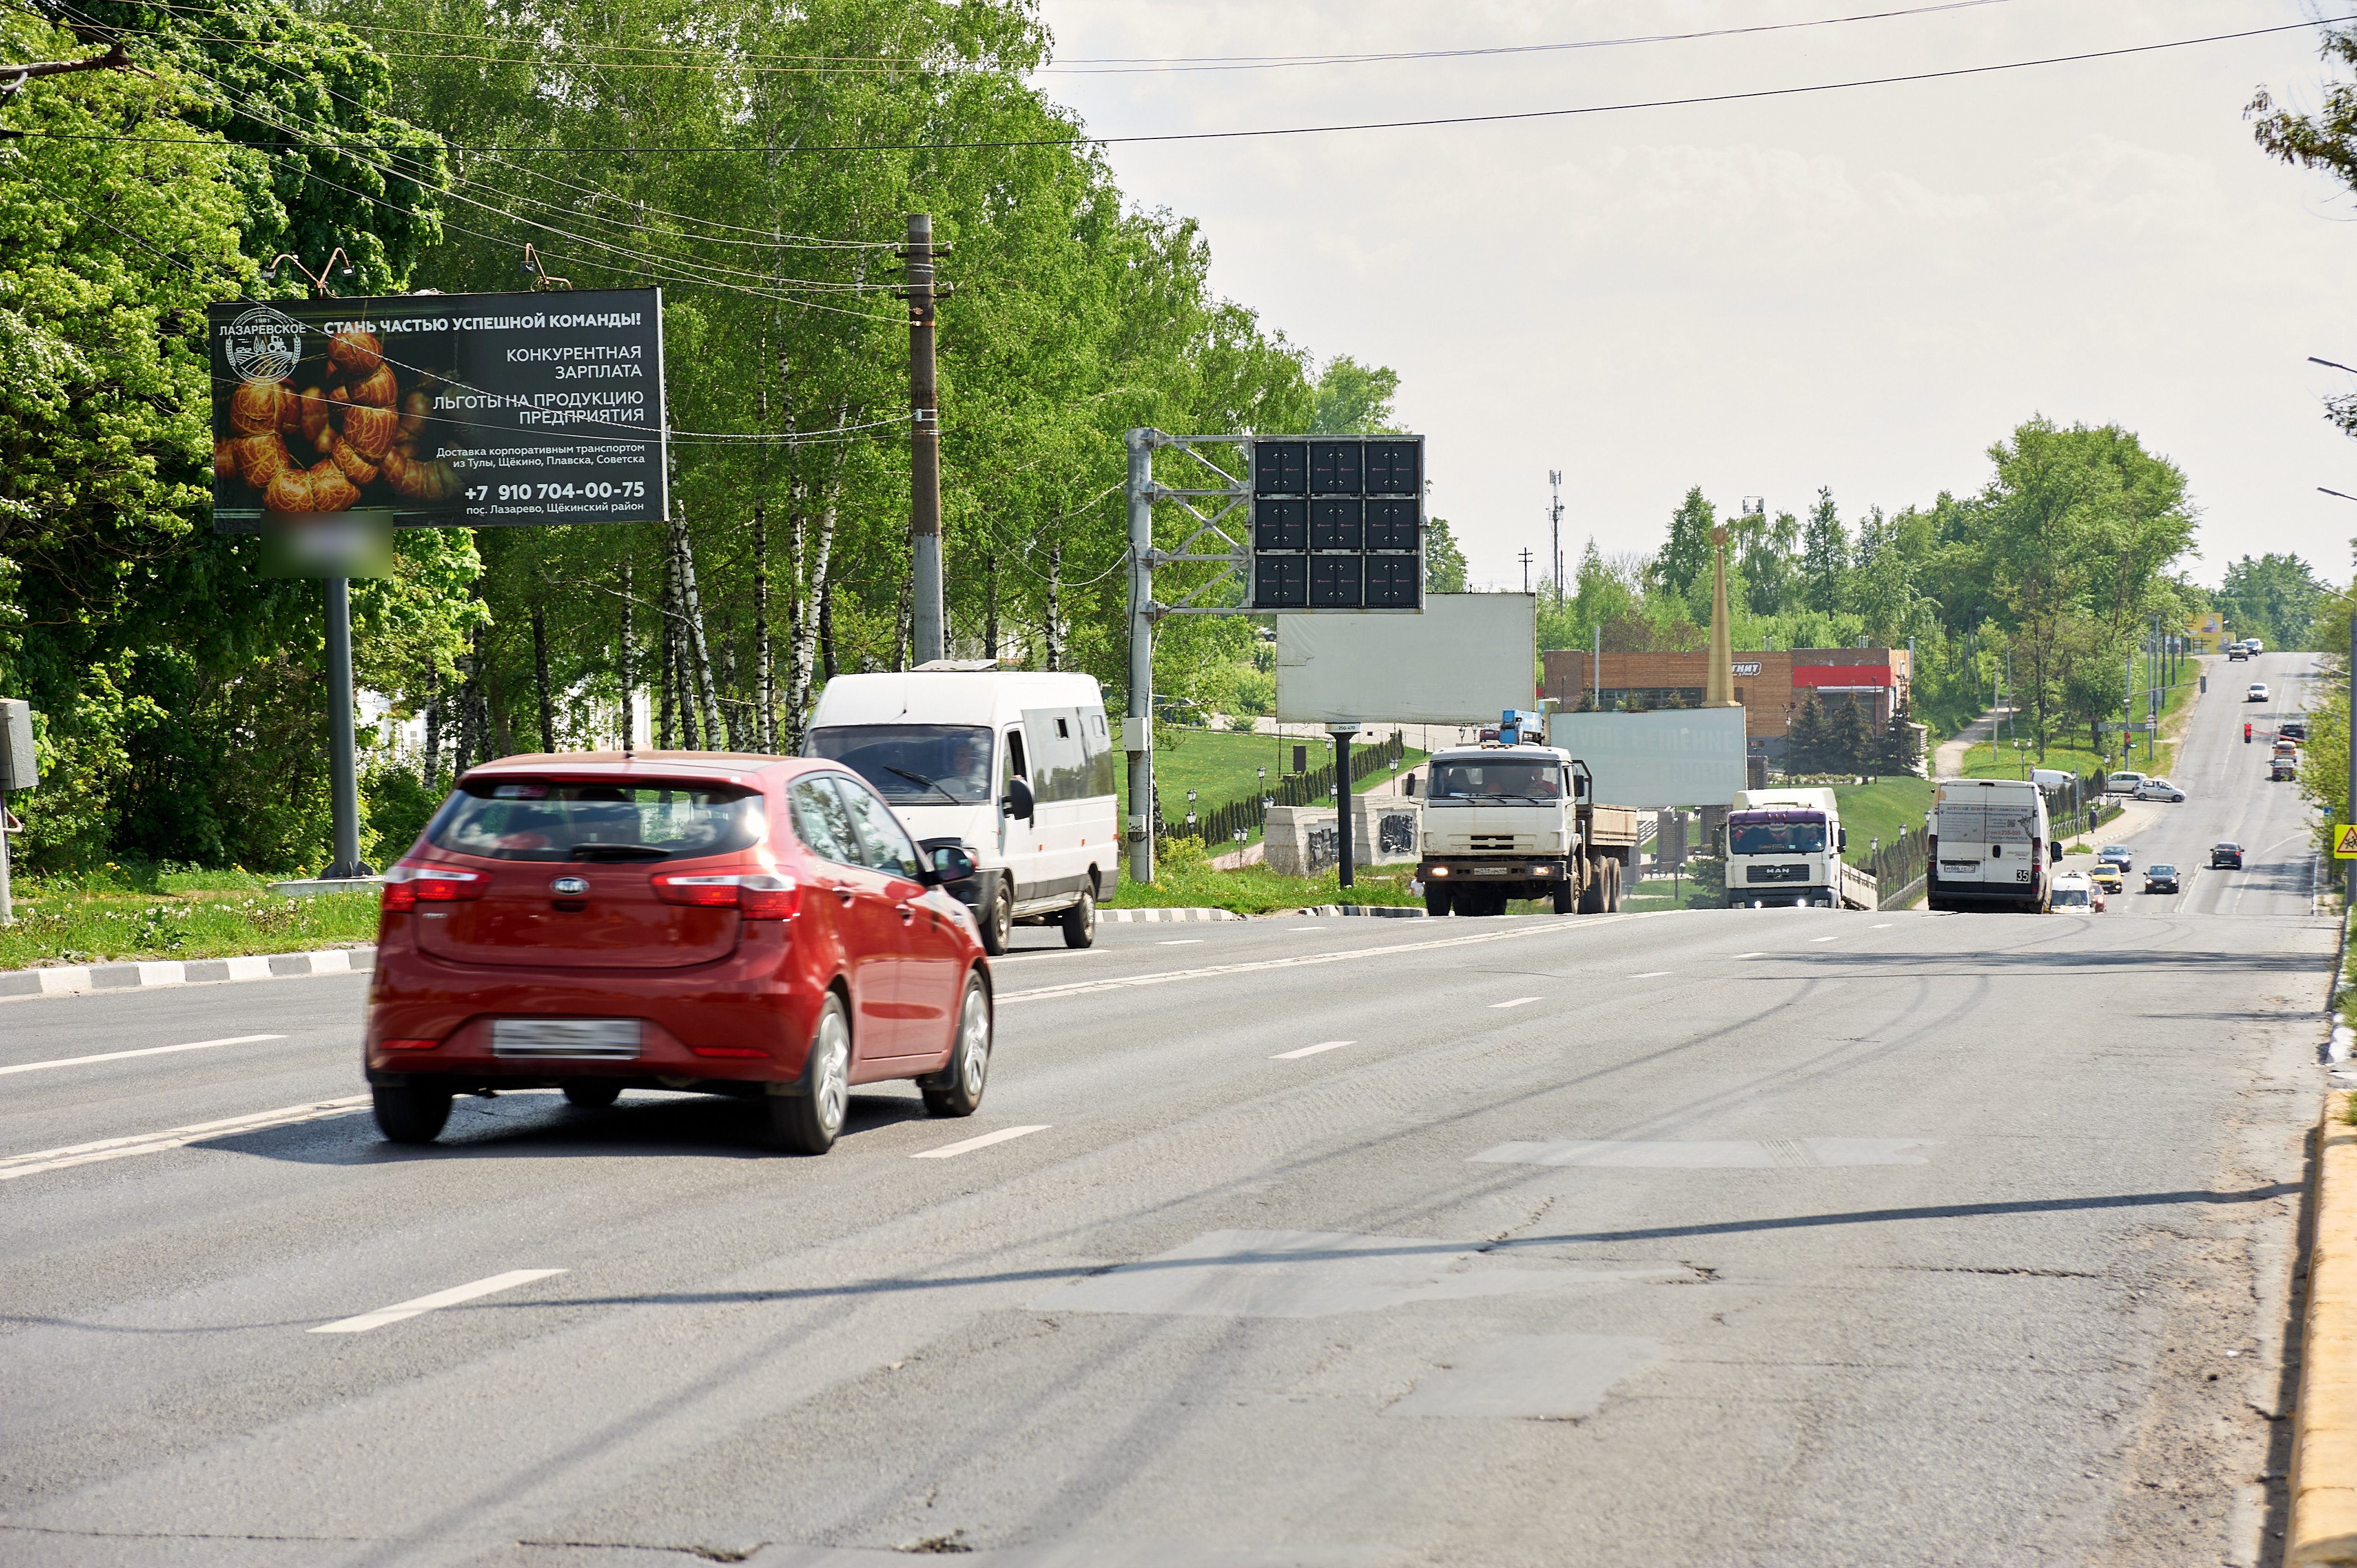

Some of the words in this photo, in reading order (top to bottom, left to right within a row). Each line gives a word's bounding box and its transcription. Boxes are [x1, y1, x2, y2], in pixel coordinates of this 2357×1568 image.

[219, 324, 307, 336] ЛАЗАРЕВСКОЕ
[324, 321, 376, 334] СТАНЬ
[380, 318, 448, 332] ЧАСТЬЮ
[452, 313, 545, 331] УСПЕШНОЙ
[550, 313, 641, 328] КОМАНДЫ!
[507, 346, 641, 362] КОНКУРЕНТНАЯ
[555, 364, 642, 379] ЗАРПЛАТА
[433, 395, 501, 409] ЛЬГОТЫ
[505, 395, 529, 408] НА
[535, 391, 643, 409] ПРОДУКЦИЮ
[520, 408, 644, 425] ПРЕДПРИЯТИЯ
[436, 448, 486, 458] Доставка
[490, 447, 573, 456] корпоративным
[576, 445, 644, 453] транспортом
[467, 458, 496, 469] Тулы,
[499, 457, 544, 468] Щёкино,
[547, 456, 594, 466] Плавска,
[597, 455, 645, 464] Советска
[465, 486, 488, 500] +7
[498, 484, 532, 500] 910
[537, 482, 644, 499] 704-00-75
[490, 506, 544, 514] Лазарево,
[547, 503, 608, 513] Щёкинский
[611, 502, 644, 512] район
[2017, 870, 2028, 881] 35
